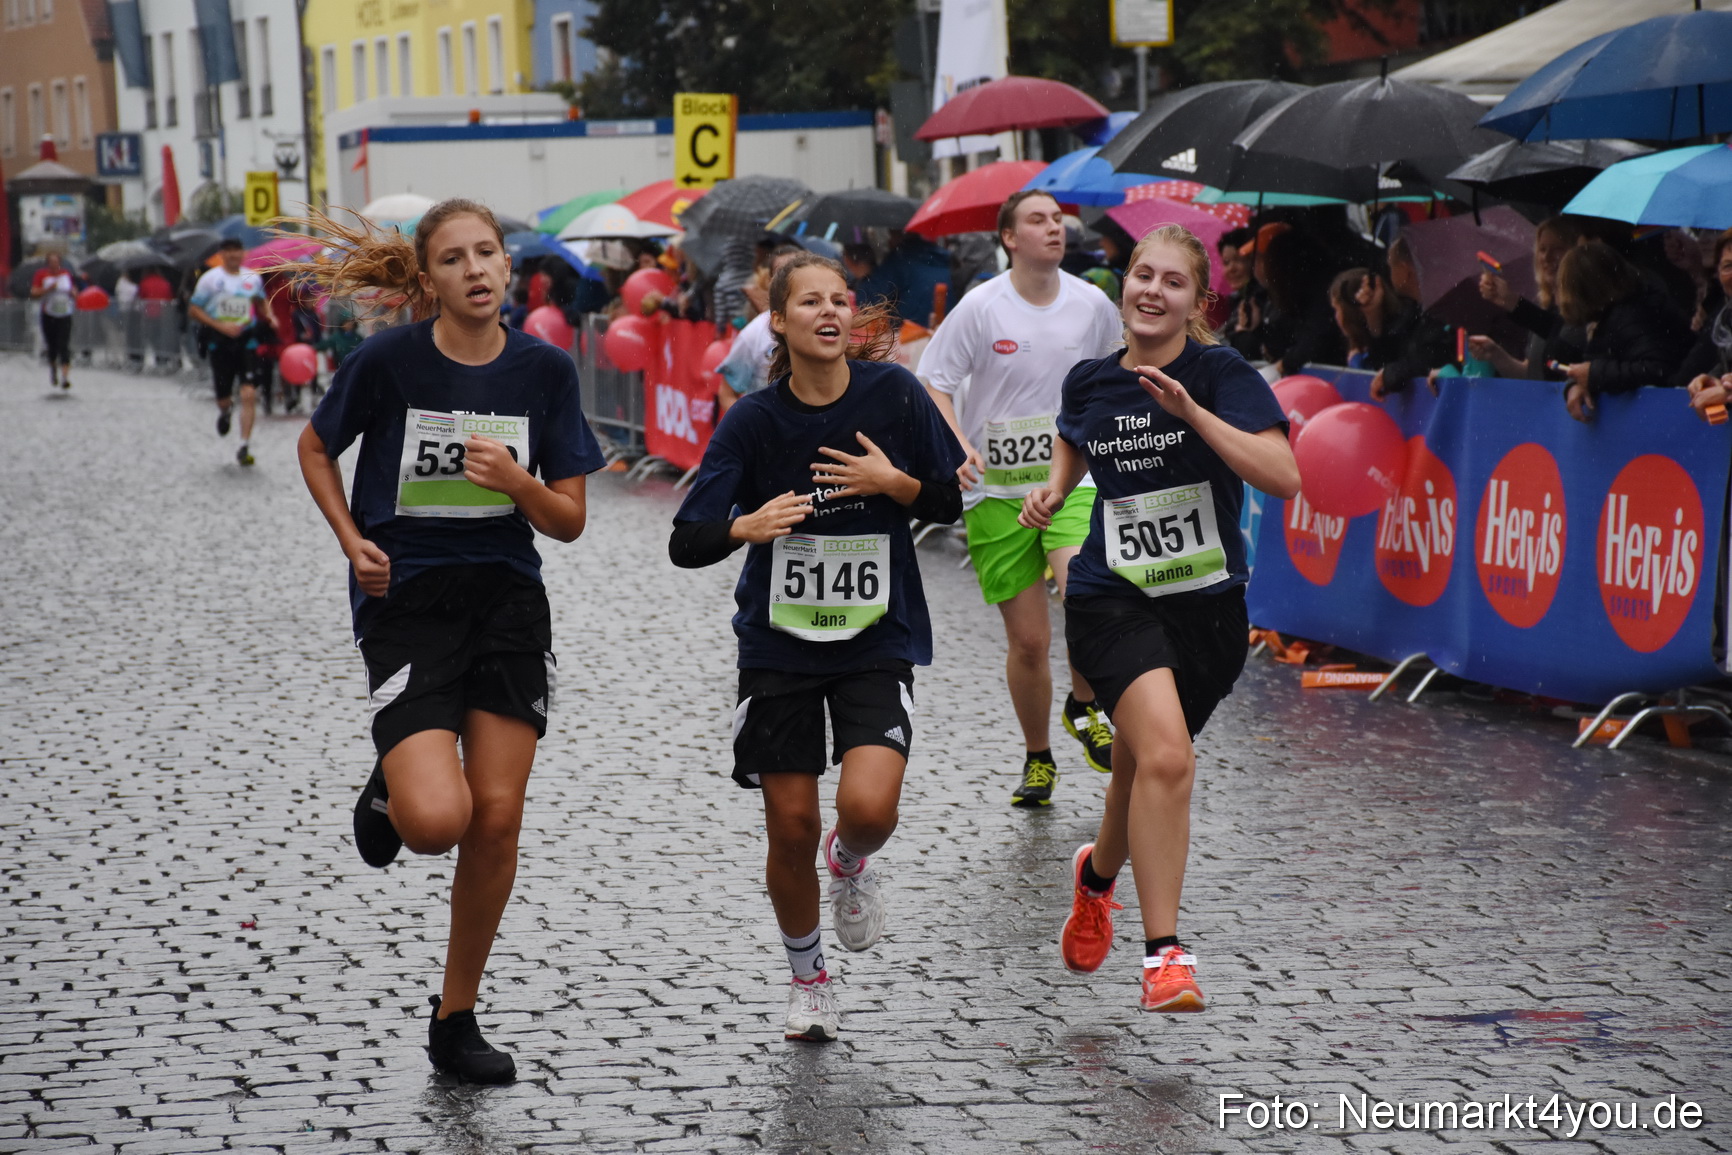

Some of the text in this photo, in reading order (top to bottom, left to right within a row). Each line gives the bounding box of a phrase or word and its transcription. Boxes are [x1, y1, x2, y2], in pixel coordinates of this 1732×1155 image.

[682, 98, 727, 116] Block
[690, 124, 720, 169] C
[253, 187, 270, 213] D
[416, 423, 455, 434] NeuerMarkt
[463, 419, 519, 435] BOCK
[1114, 412, 1151, 432] Titel
[988, 433, 1053, 466] 5323
[1087, 430, 1186, 457] Verteidiger
[1114, 455, 1164, 473] Innen
[1144, 487, 1201, 509] BOCK
[1118, 508, 1206, 561] 5051
[1379, 479, 1454, 573] Hervis
[1483, 479, 1562, 592] Hervis
[783, 544, 817, 554] NeuerMarkt
[823, 539, 880, 552] BOCK
[1604, 493, 1698, 615] Hervis
[784, 559, 879, 601] 5146
[1145, 563, 1194, 584] Hanna
[1488, 574, 1528, 598] SPORTS
[811, 611, 847, 627] Jana
[1610, 595, 1651, 620] SPORTS
[884, 731, 906, 747] adidas
